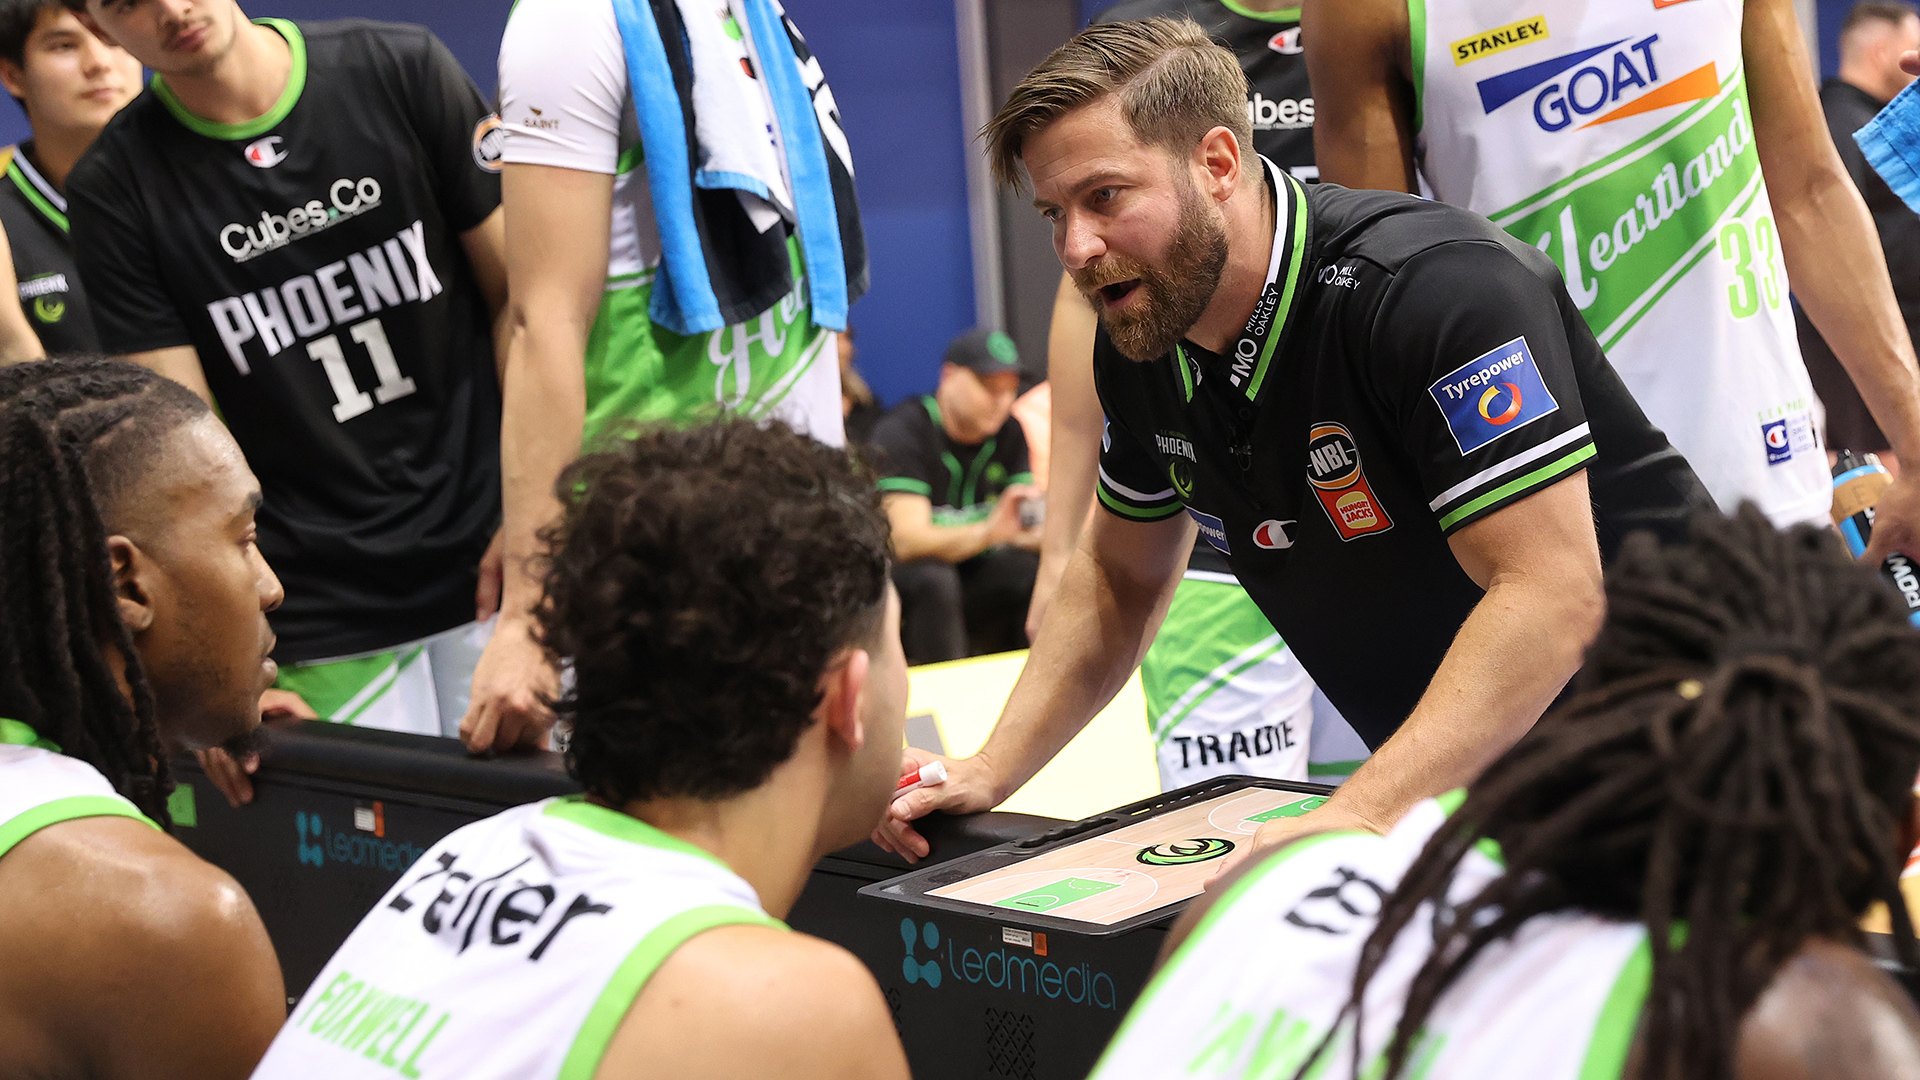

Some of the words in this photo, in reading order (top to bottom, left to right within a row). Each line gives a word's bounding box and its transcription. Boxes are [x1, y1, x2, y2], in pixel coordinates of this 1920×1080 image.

[1533, 33, 1659, 132] GOAT
[219, 176, 383, 260] Cubes.Co
[1718, 214, 1781, 322] 33
[206, 219, 444, 376] PHOENIX
[1245, 300, 1264, 333] MILLS
[1254, 287, 1279, 337] OAKLEY
[305, 317, 418, 424] 11
[1441, 350, 1525, 400] Tyrepower
[1155, 433, 1198, 464] PHOENIX
[1309, 440, 1353, 477] NBL
[1339, 500, 1370, 515] HUNGRY
[1173, 718, 1295, 768] TRADIE
[296, 970, 452, 1079] FOXWELL
